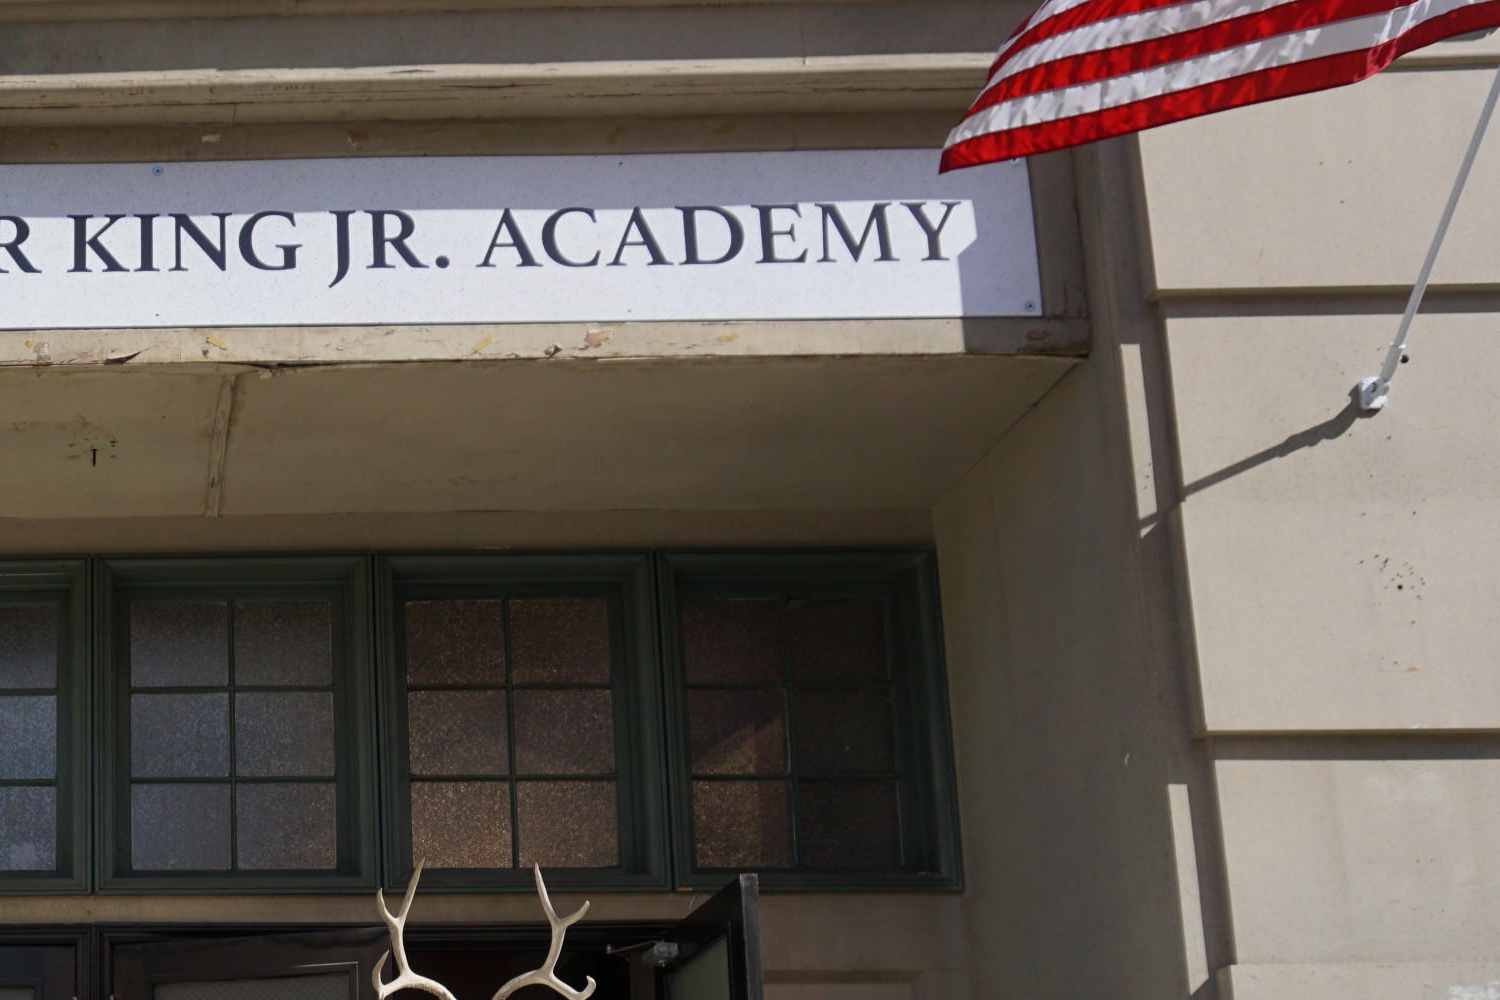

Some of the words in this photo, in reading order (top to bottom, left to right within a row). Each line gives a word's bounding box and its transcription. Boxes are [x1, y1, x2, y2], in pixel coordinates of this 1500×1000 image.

[66, 210, 303, 273] KING
[328, 207, 449, 289] JR.
[475, 202, 963, 268] ACADEMY
